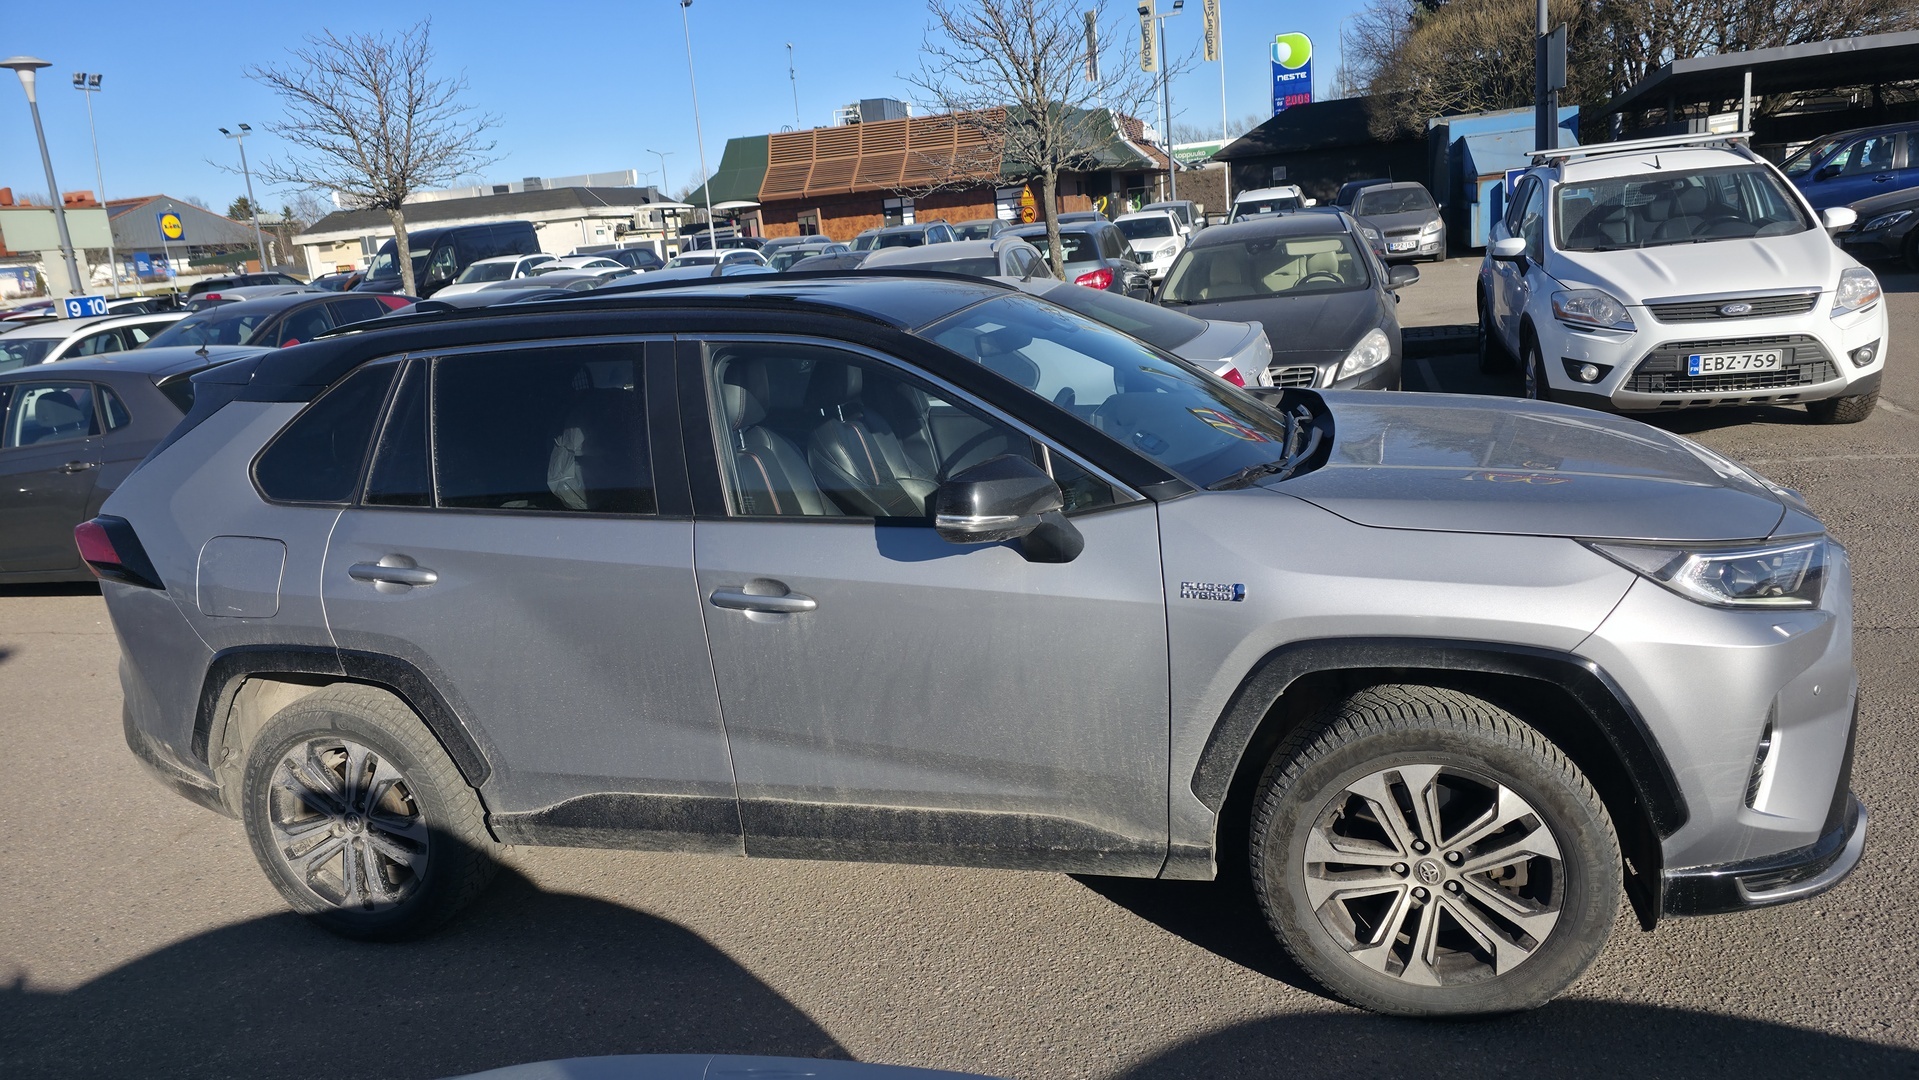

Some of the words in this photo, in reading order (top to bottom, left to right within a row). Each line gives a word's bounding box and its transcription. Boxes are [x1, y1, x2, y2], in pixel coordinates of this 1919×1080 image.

[1277, 71, 1307, 82] NESTE
[70, 301, 82, 317] 9
[87, 298, 106, 315] 10
[1702, 353, 1777, 372] EBZ-759
[1180, 590, 1231, 601] HYBRID
